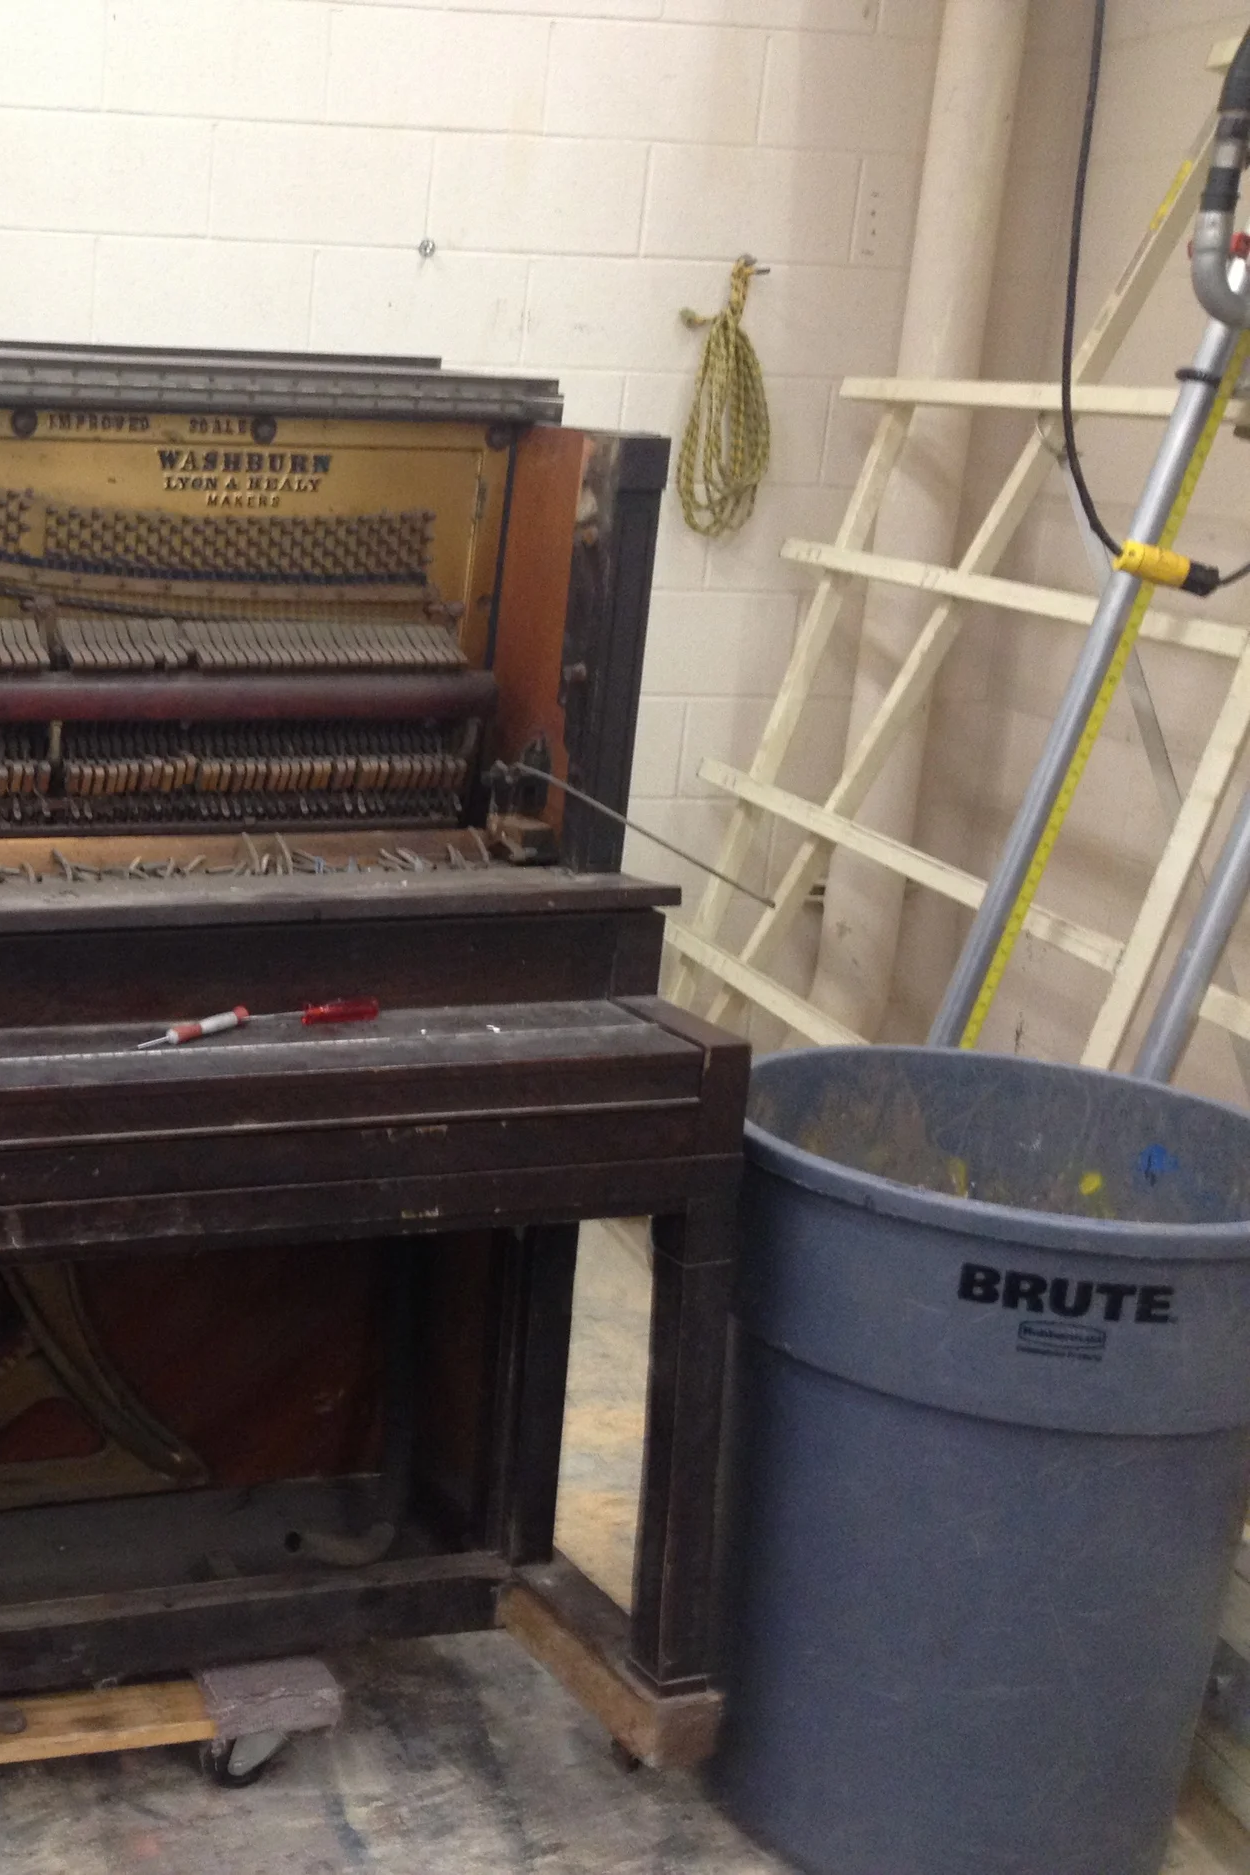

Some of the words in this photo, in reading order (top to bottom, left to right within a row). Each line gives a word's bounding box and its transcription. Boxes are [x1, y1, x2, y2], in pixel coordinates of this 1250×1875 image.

[49, 411, 150, 432] IMPROVED
[189, 417, 247, 435] SCALE
[158, 450, 332, 474] WASHBURN
[164, 475, 219, 491] LYON
[246, 475, 321, 492] HEALY
[206, 493, 280, 509] MAKERS
[957, 1261, 1177, 1324] BRUTE
